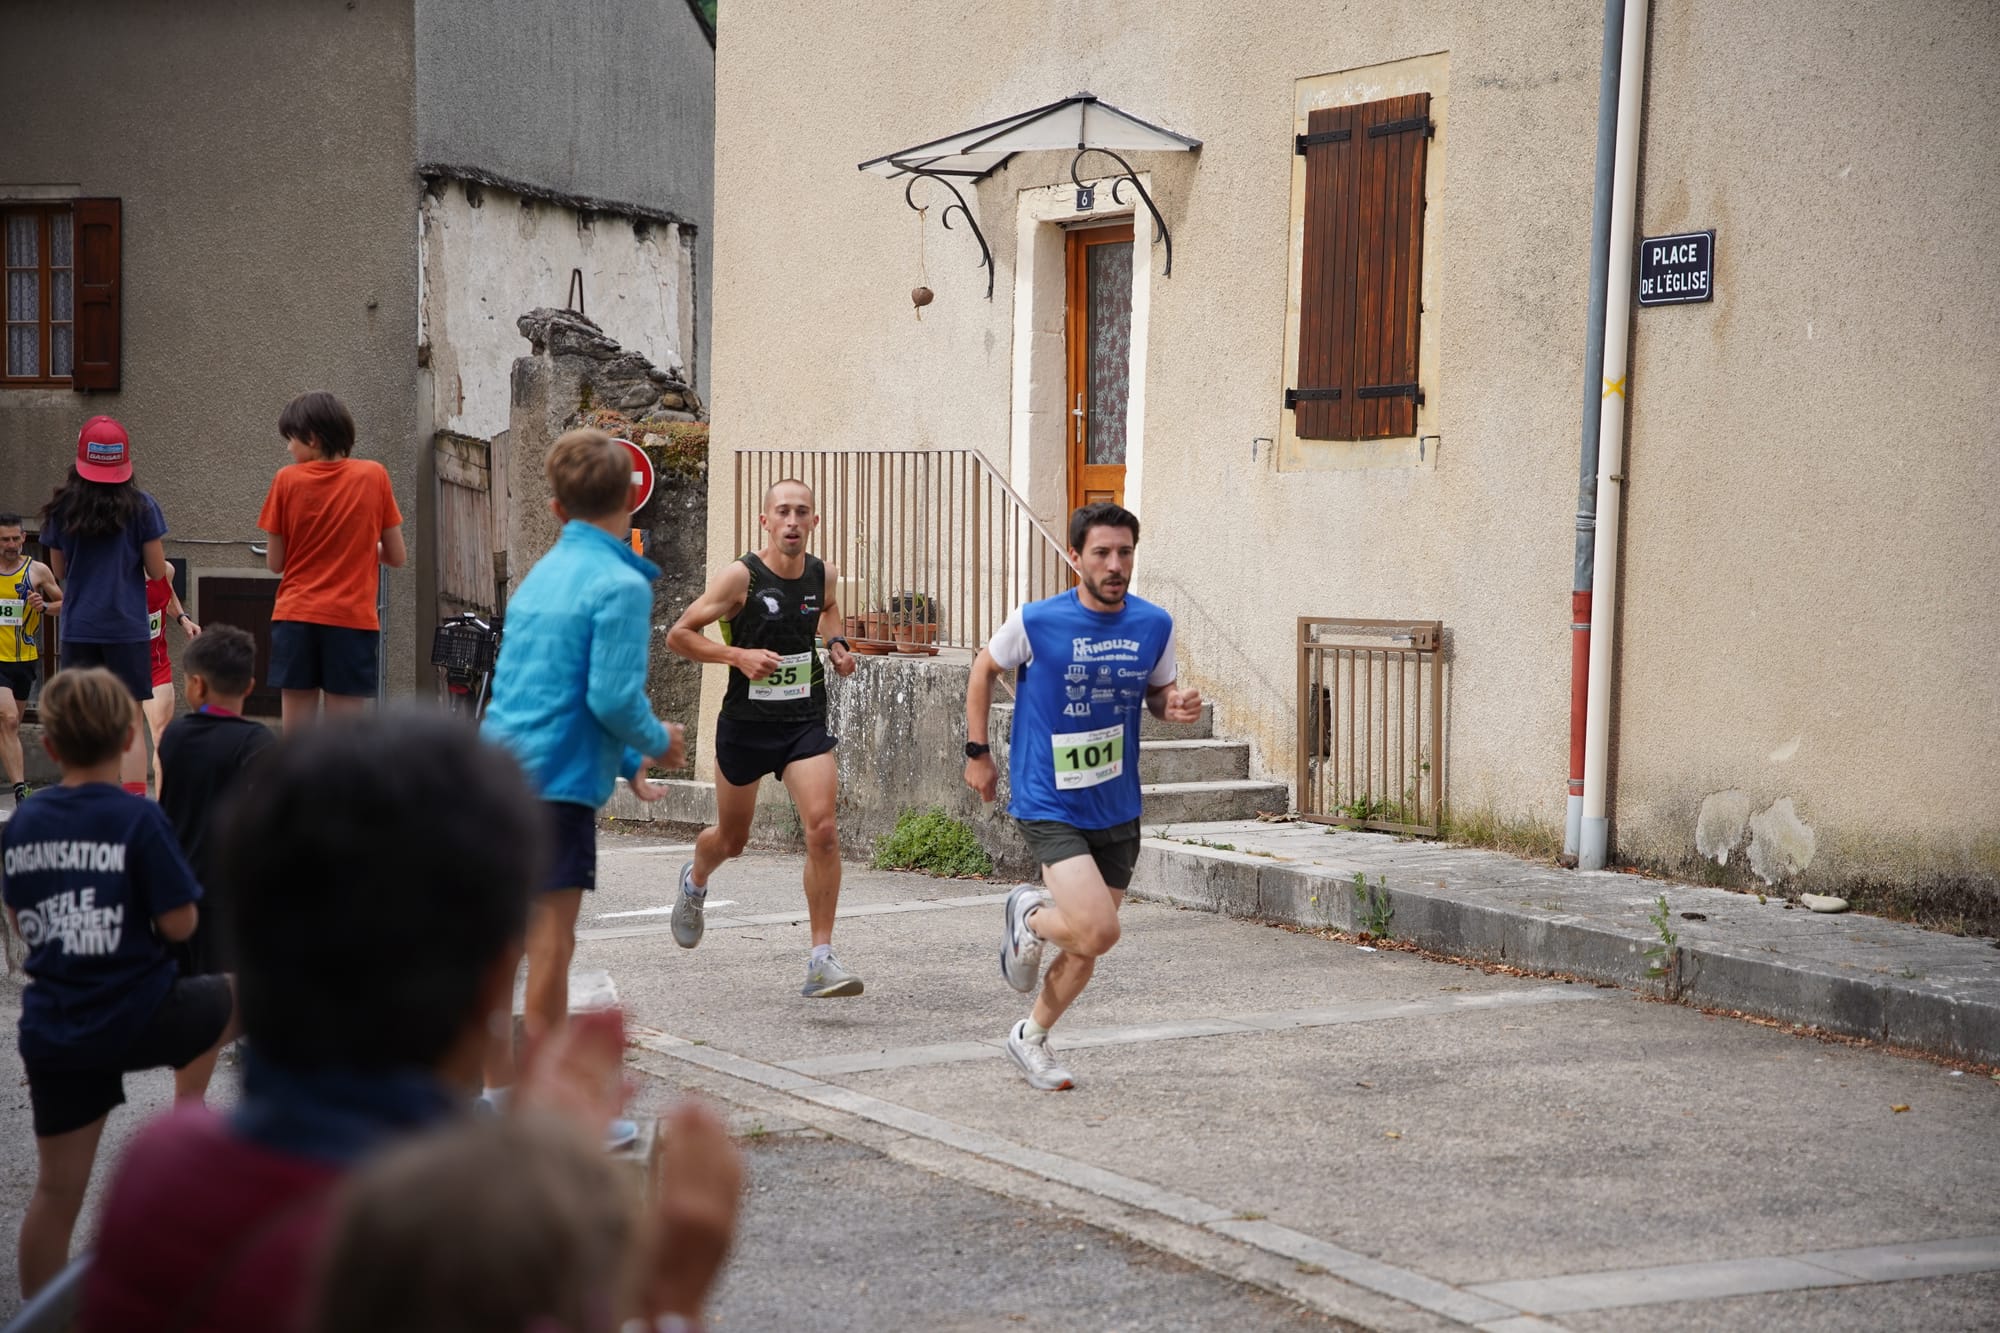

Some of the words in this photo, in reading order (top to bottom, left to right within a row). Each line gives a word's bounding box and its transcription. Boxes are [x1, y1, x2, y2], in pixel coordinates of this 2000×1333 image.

[1081, 191, 1088, 207] 6
[1652, 243, 1697, 266] PLACE
[1642, 278, 1654, 295] DE
[1656, 270, 1707, 293] L'ÉGLISE
[768, 667, 797, 686] 55
[1066, 741, 1113, 769] 101
[5, 842, 126, 875] ORGANISATION
